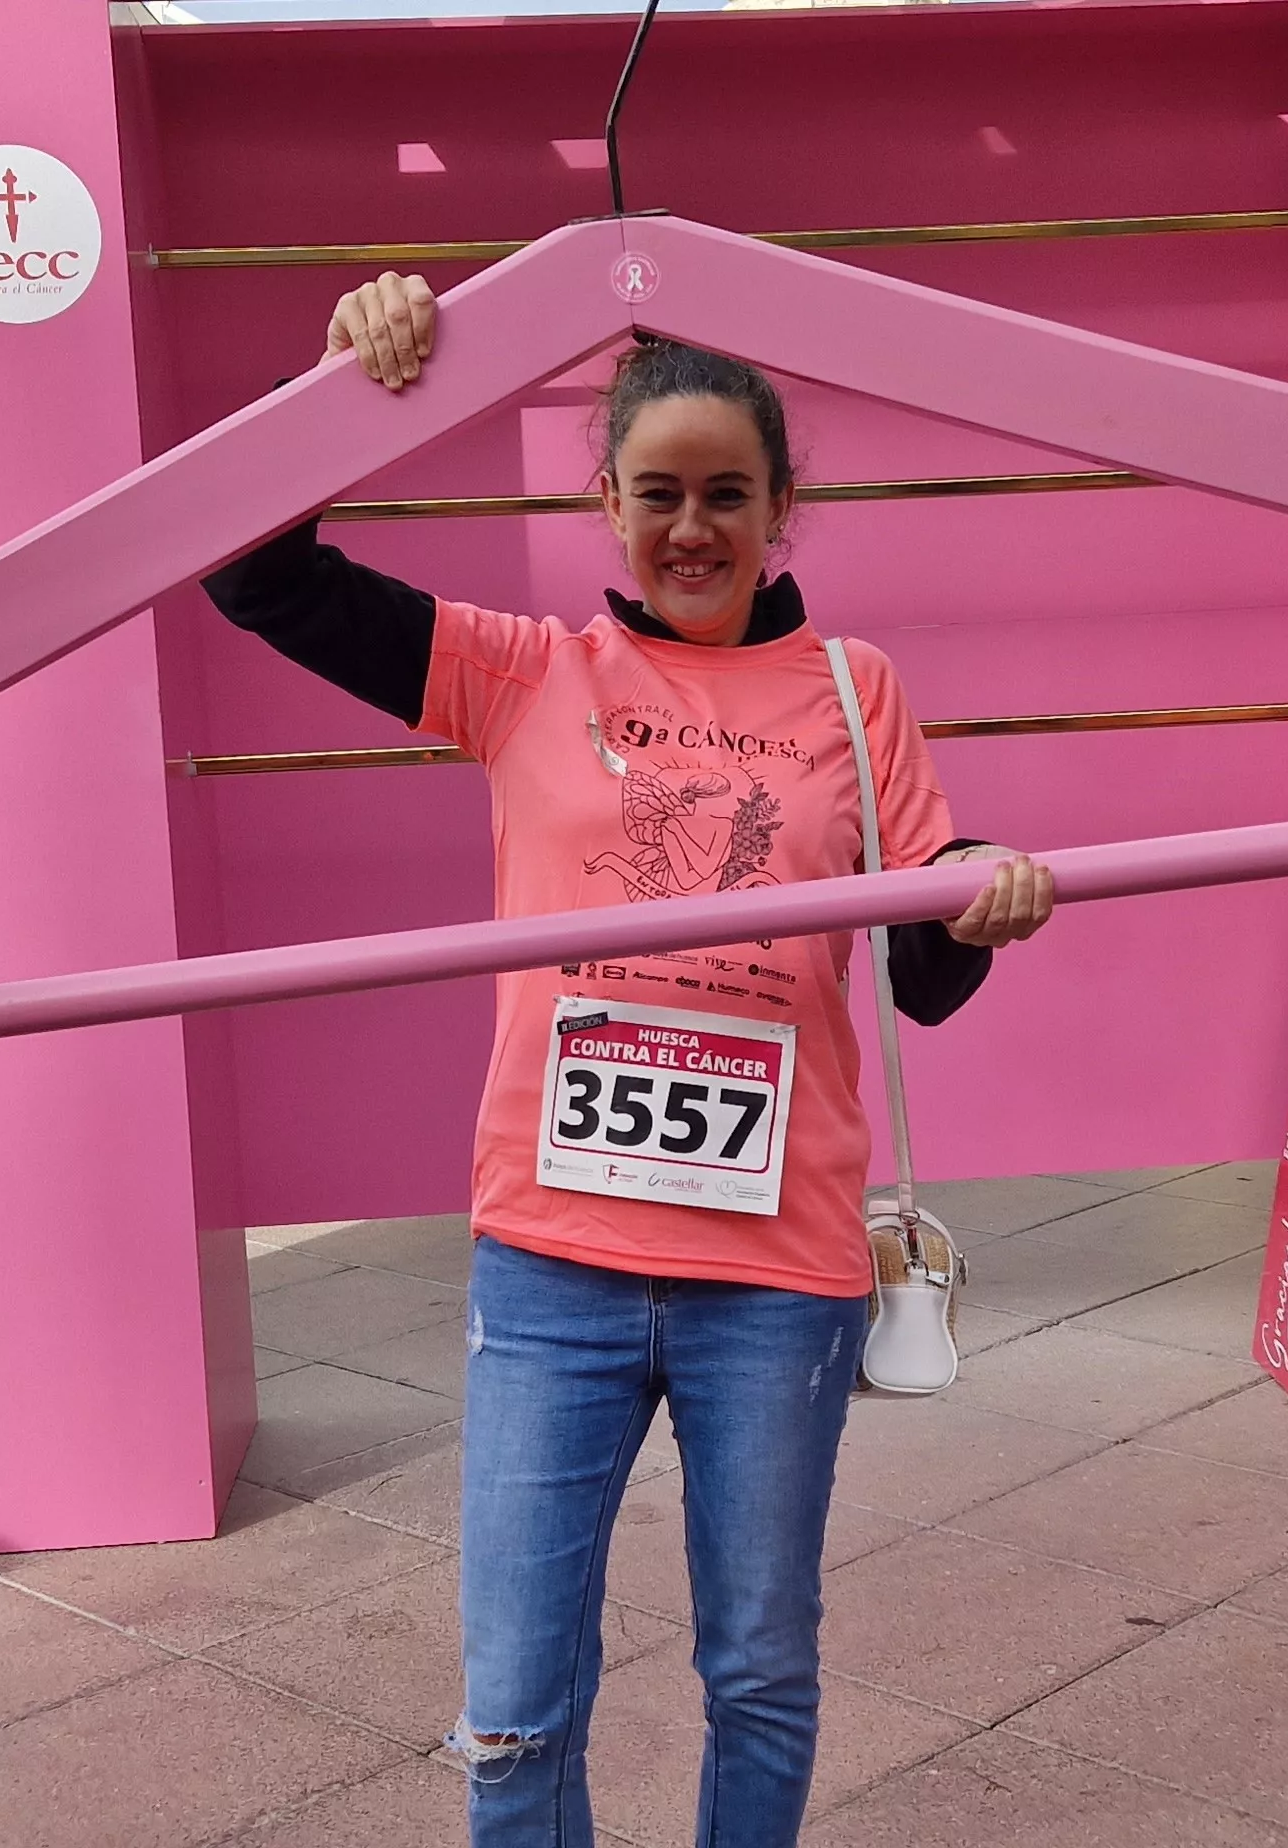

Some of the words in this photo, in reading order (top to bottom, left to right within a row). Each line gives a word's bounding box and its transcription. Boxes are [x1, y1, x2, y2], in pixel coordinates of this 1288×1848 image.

[13, 283, 21, 294] el
[26, 283, 63, 294] Cáncer
[638, 1029, 700, 1049] HUESCA
[570, 1038, 651, 1063] CONTRA
[657, 1049, 679, 1067] EL
[686, 1051, 767, 1078] CÁNCER
[558, 1069, 768, 1160] 3557
[662, 1178, 704, 1191] castellar
